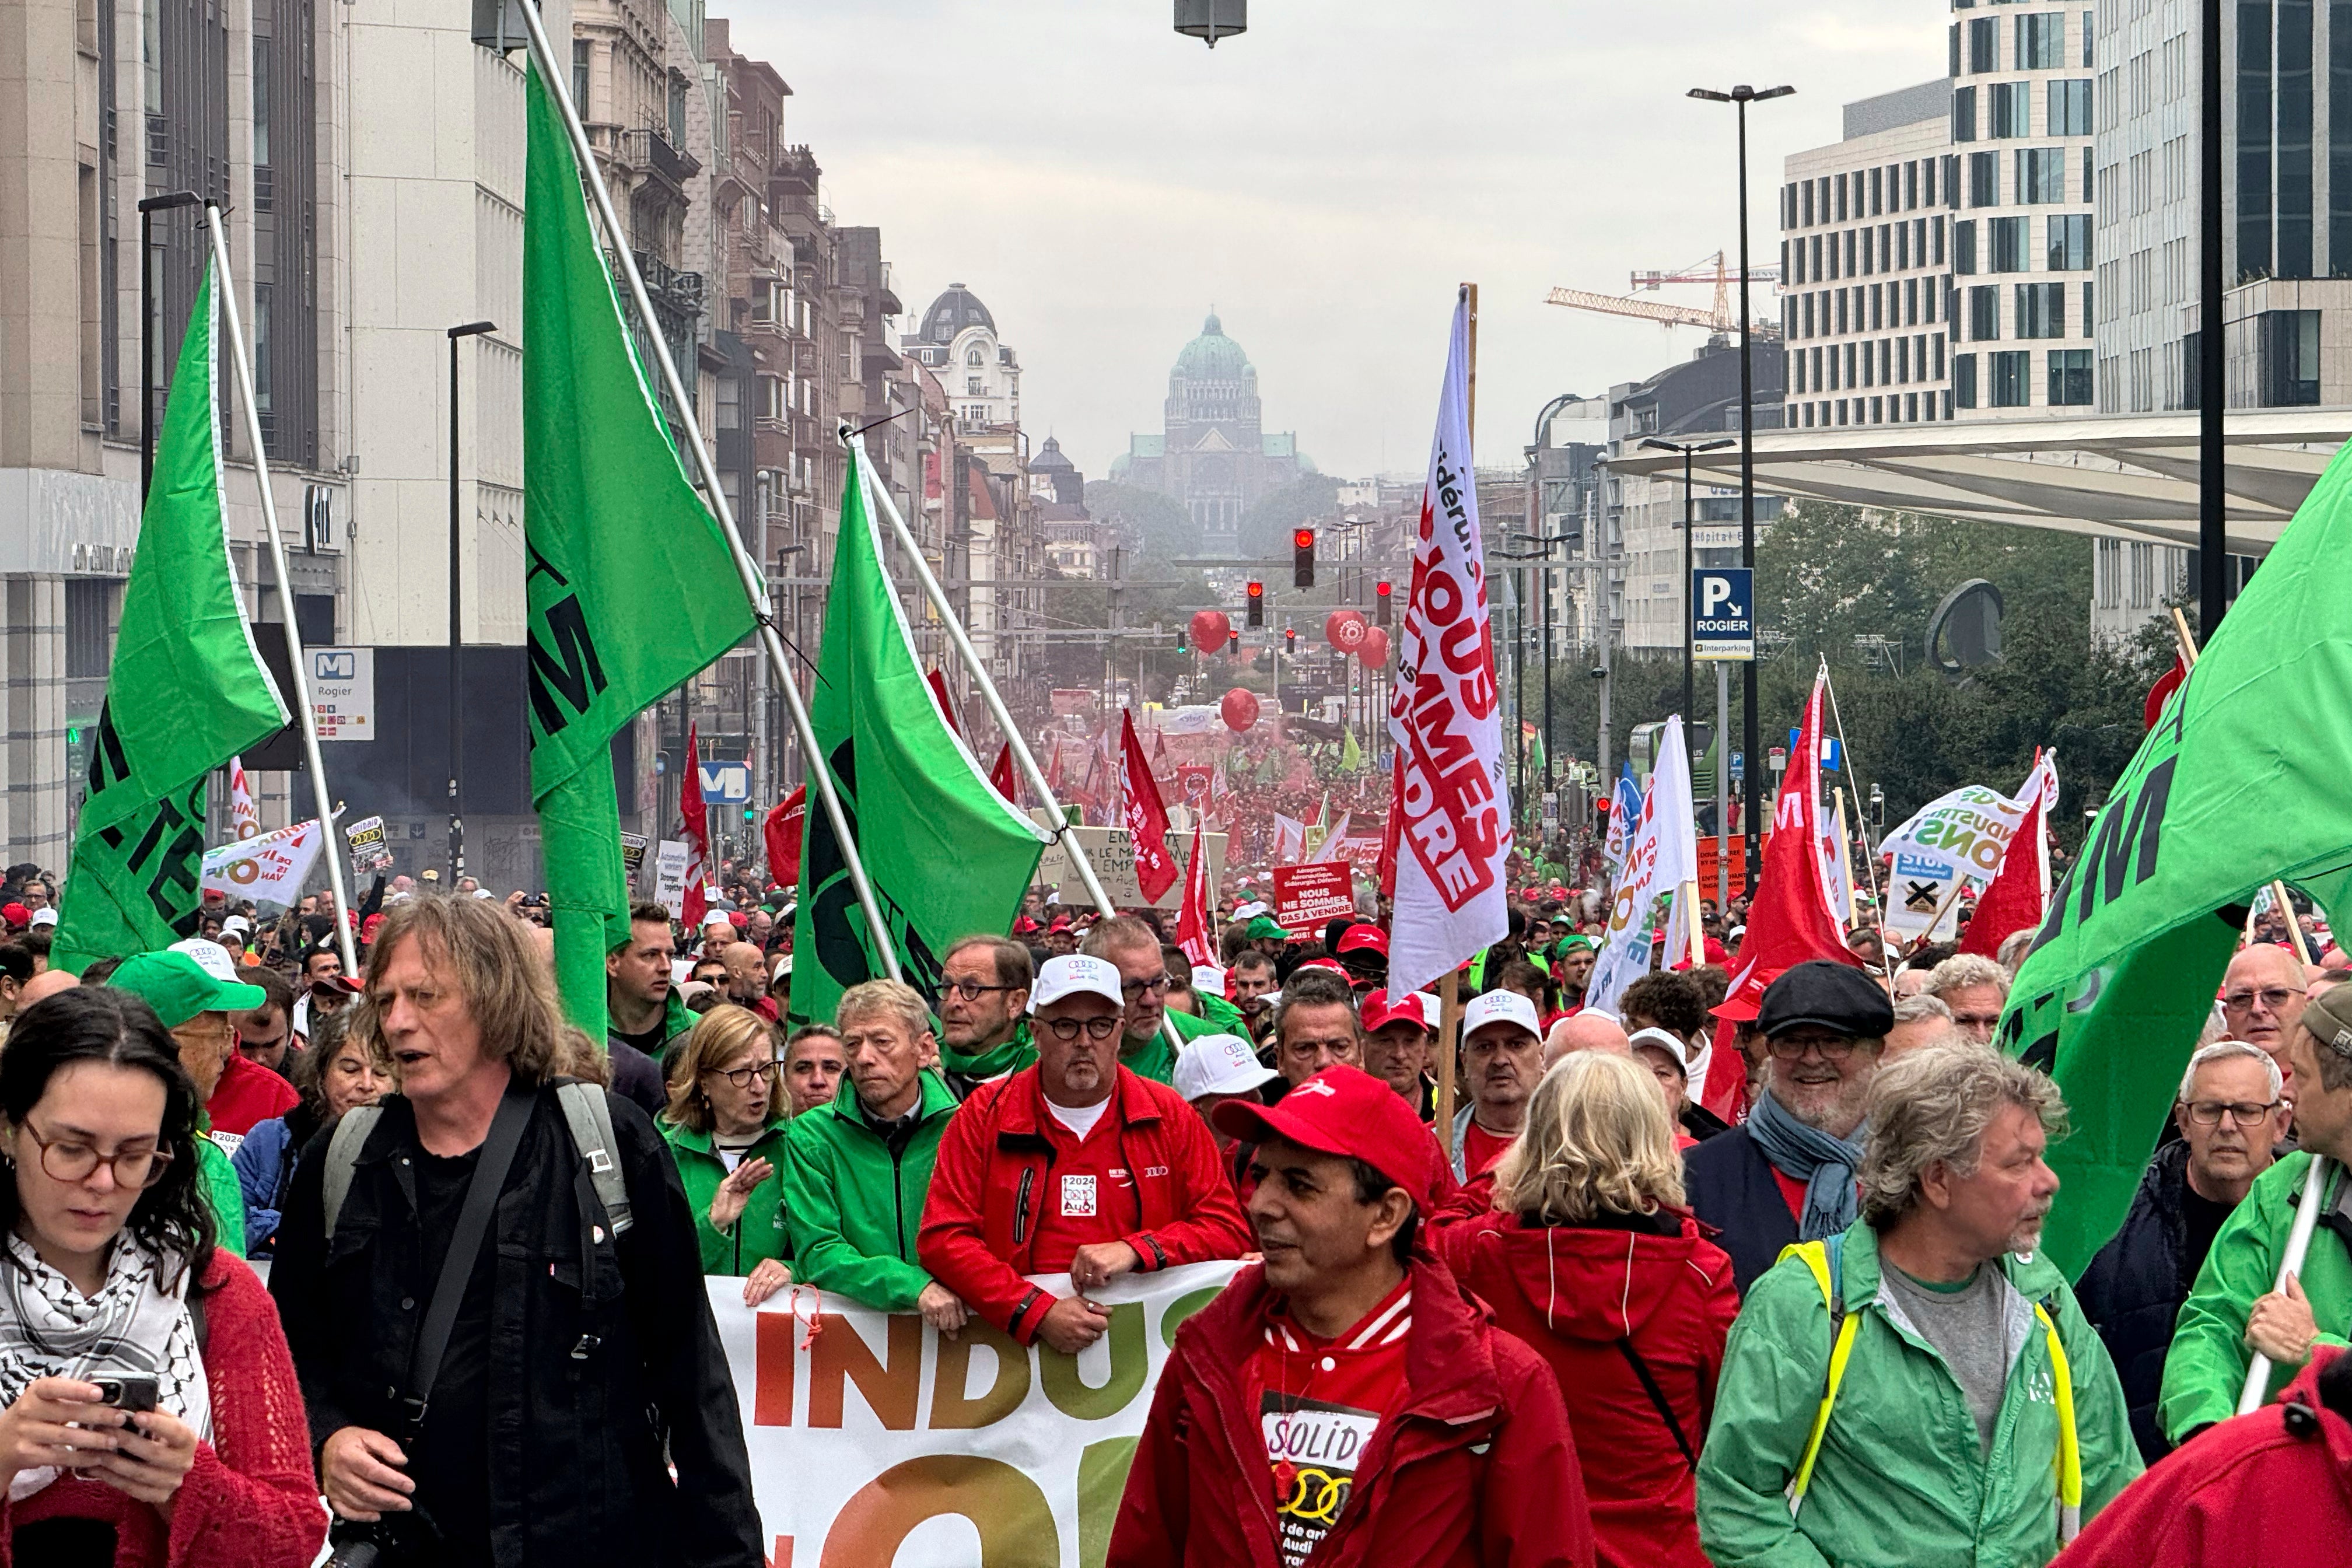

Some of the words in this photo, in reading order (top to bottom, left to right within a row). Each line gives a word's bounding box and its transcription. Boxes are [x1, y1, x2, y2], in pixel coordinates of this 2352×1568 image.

[1703, 577, 1731, 617] P
[1697, 620, 1749, 631] ROGIER
[318, 687, 352, 698] Rogier
[1298, 888, 1330, 899] NOUS
[1282, 901, 1298, 911] NE
[1300, 895, 1348, 908] SOMMES
[1281, 913, 1301, 923] PAS
[1310, 904, 1352, 918] VENDRE
[219, 1133, 243, 1143] 2024
[1287, 1523, 1303, 1536] de
[1283, 1538, 1312, 1553] Audi
